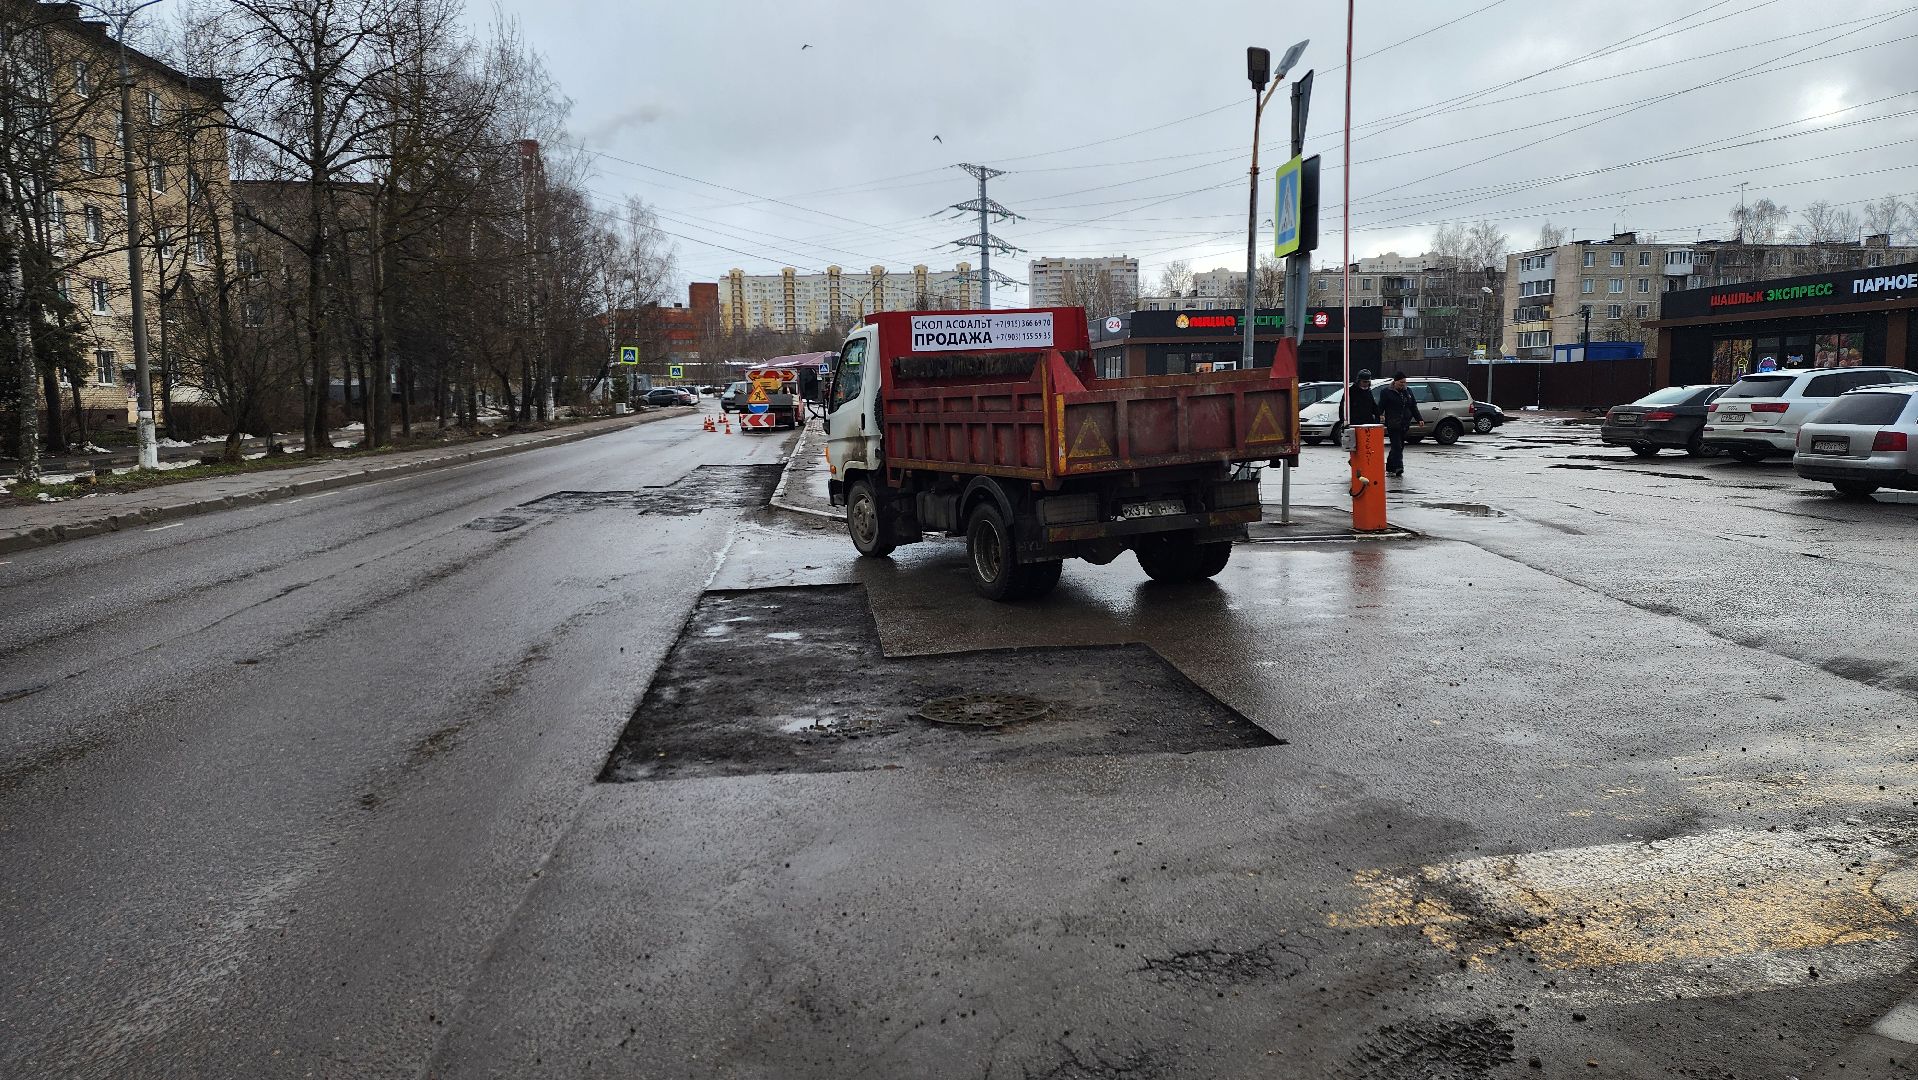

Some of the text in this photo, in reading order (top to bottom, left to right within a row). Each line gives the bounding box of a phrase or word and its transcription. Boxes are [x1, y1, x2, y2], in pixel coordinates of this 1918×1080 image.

[1852, 273, 1918, 294] ПАРНОЕ
[1710, 282, 1833, 307] ШАШЛЫК ЭКСПРЕСС
[914, 320, 943, 330] СКОЛ
[945, 318, 993, 329] АСФАЛЬТ
[1108, 319, 1121, 329] 24
[914, 331, 993, 347] ПРОДАЖА
